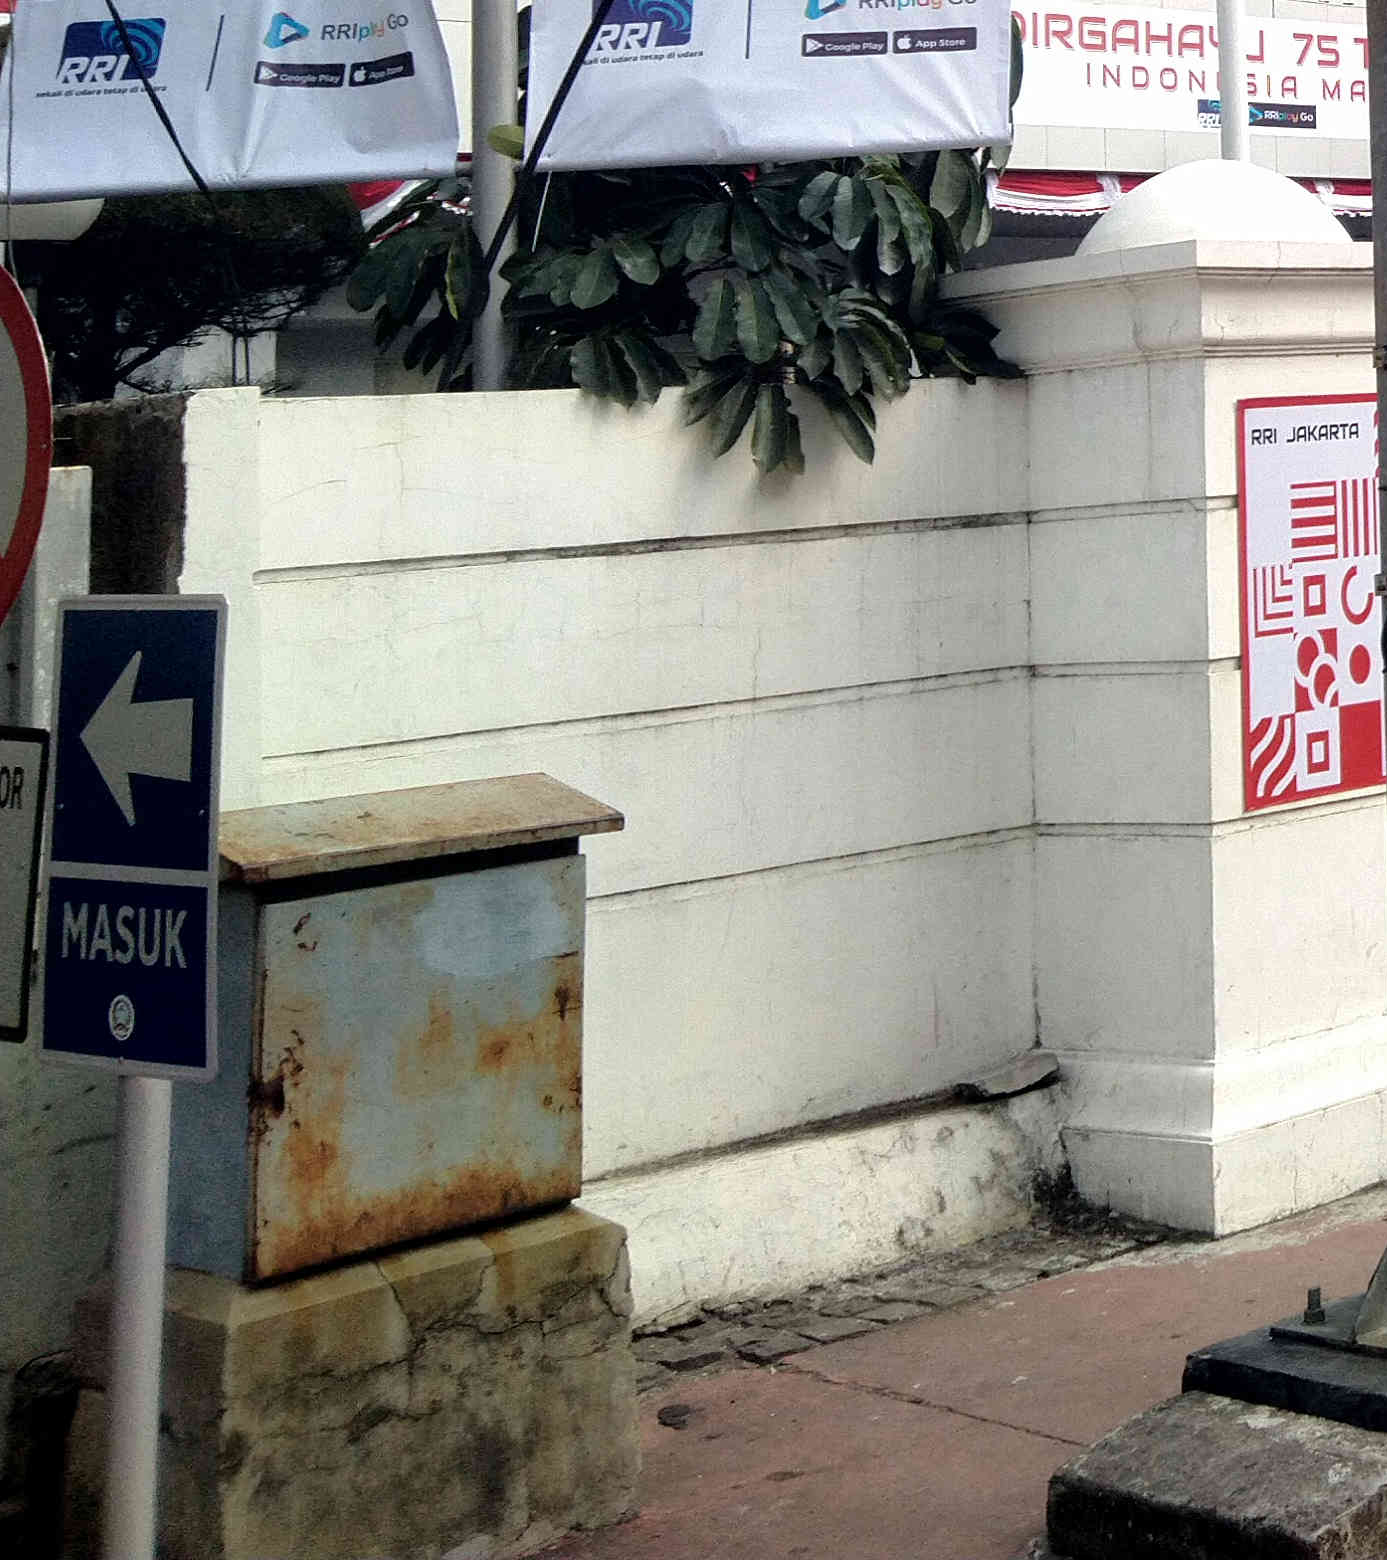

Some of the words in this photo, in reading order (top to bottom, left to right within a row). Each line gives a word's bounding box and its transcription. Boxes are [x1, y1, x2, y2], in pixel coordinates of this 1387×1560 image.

[386, 13, 409, 30] Go
[591, 21, 662, 51] RRI
[824, 42, 861, 52] Google
[862, 41, 885, 52] Play
[915, 40, 937, 49] App
[938, 38, 967, 47] Store
[1292, 32, 1341, 68] 75
[57, 54, 131, 84] RRI
[1299, 111, 1314, 123] Go
[1251, 428, 1277, 446] RRI
[1286, 422, 1359, 443] JAKARTA
[61, 901, 187, 969] MASUK
